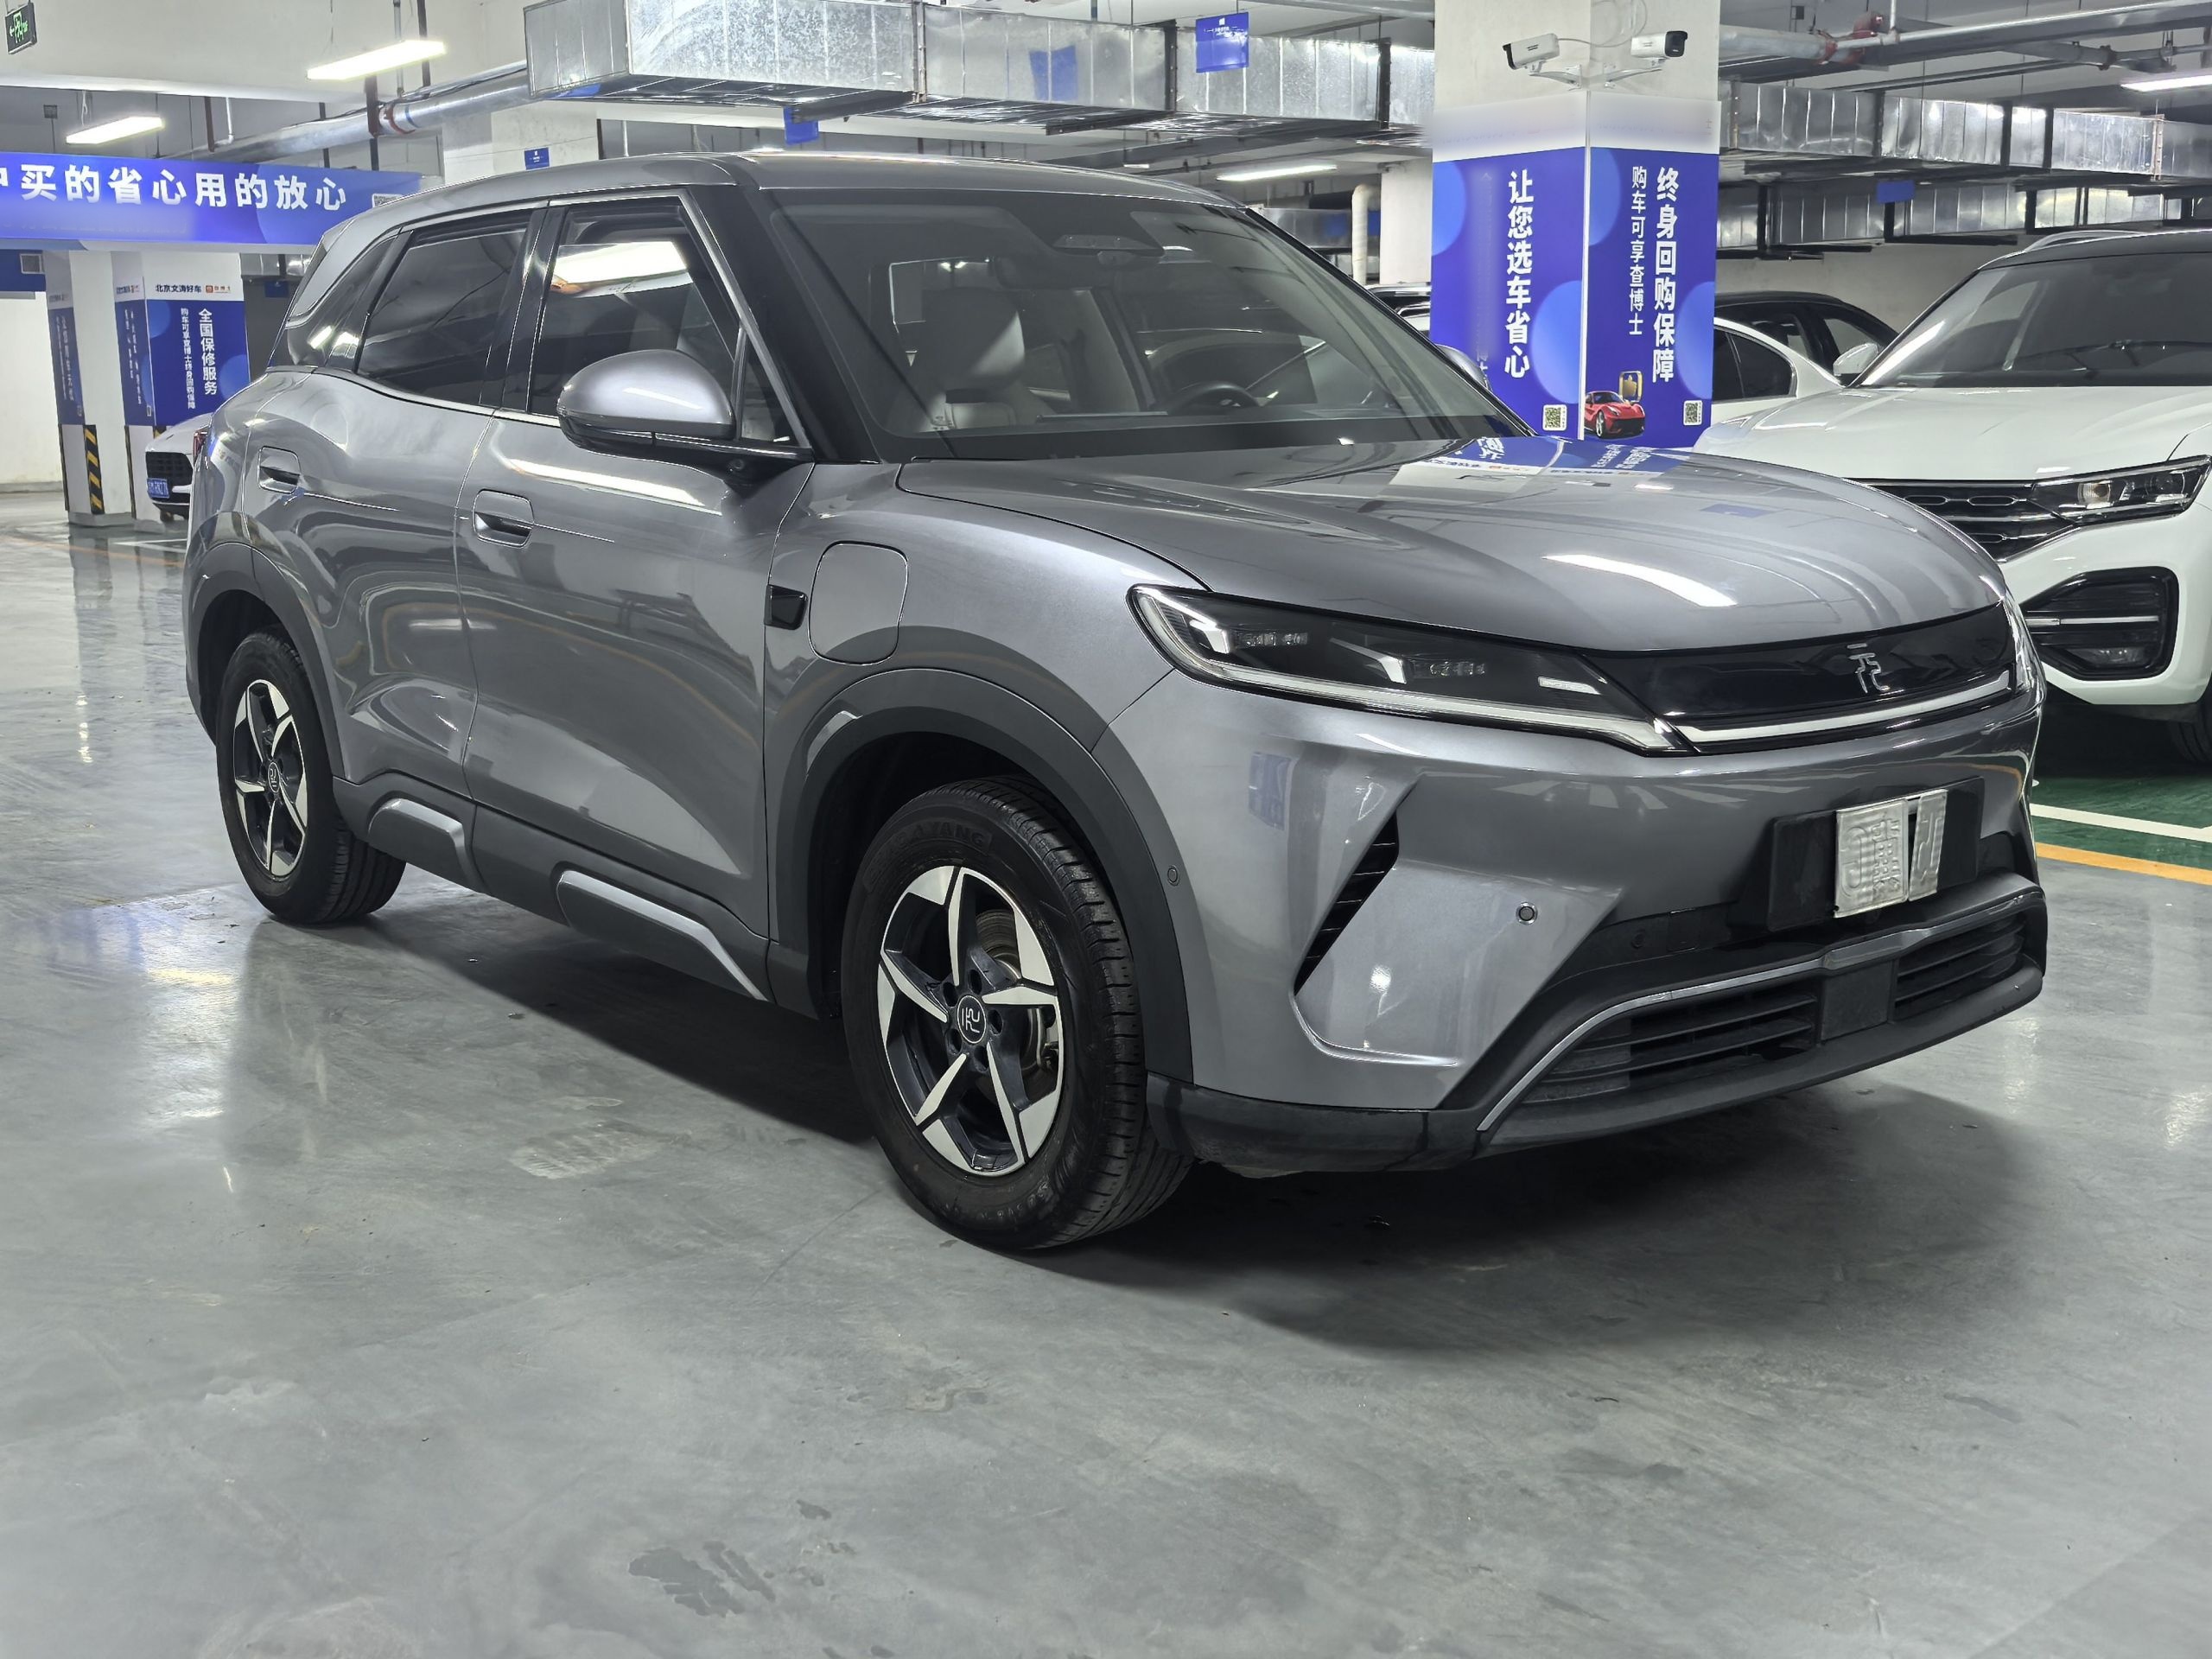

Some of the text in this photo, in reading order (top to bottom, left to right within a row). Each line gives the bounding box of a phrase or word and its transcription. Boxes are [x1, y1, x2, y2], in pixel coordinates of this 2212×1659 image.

[0, 163, 346, 212] 买的省心用的放心
[1628, 166, 1647, 336] 购车可享查博士
[199, 308, 218, 396] 全国保修服务
[1504, 169, 1534, 378] 让您选车省心
[1652, 167, 1679, 383] 终身回购保障
